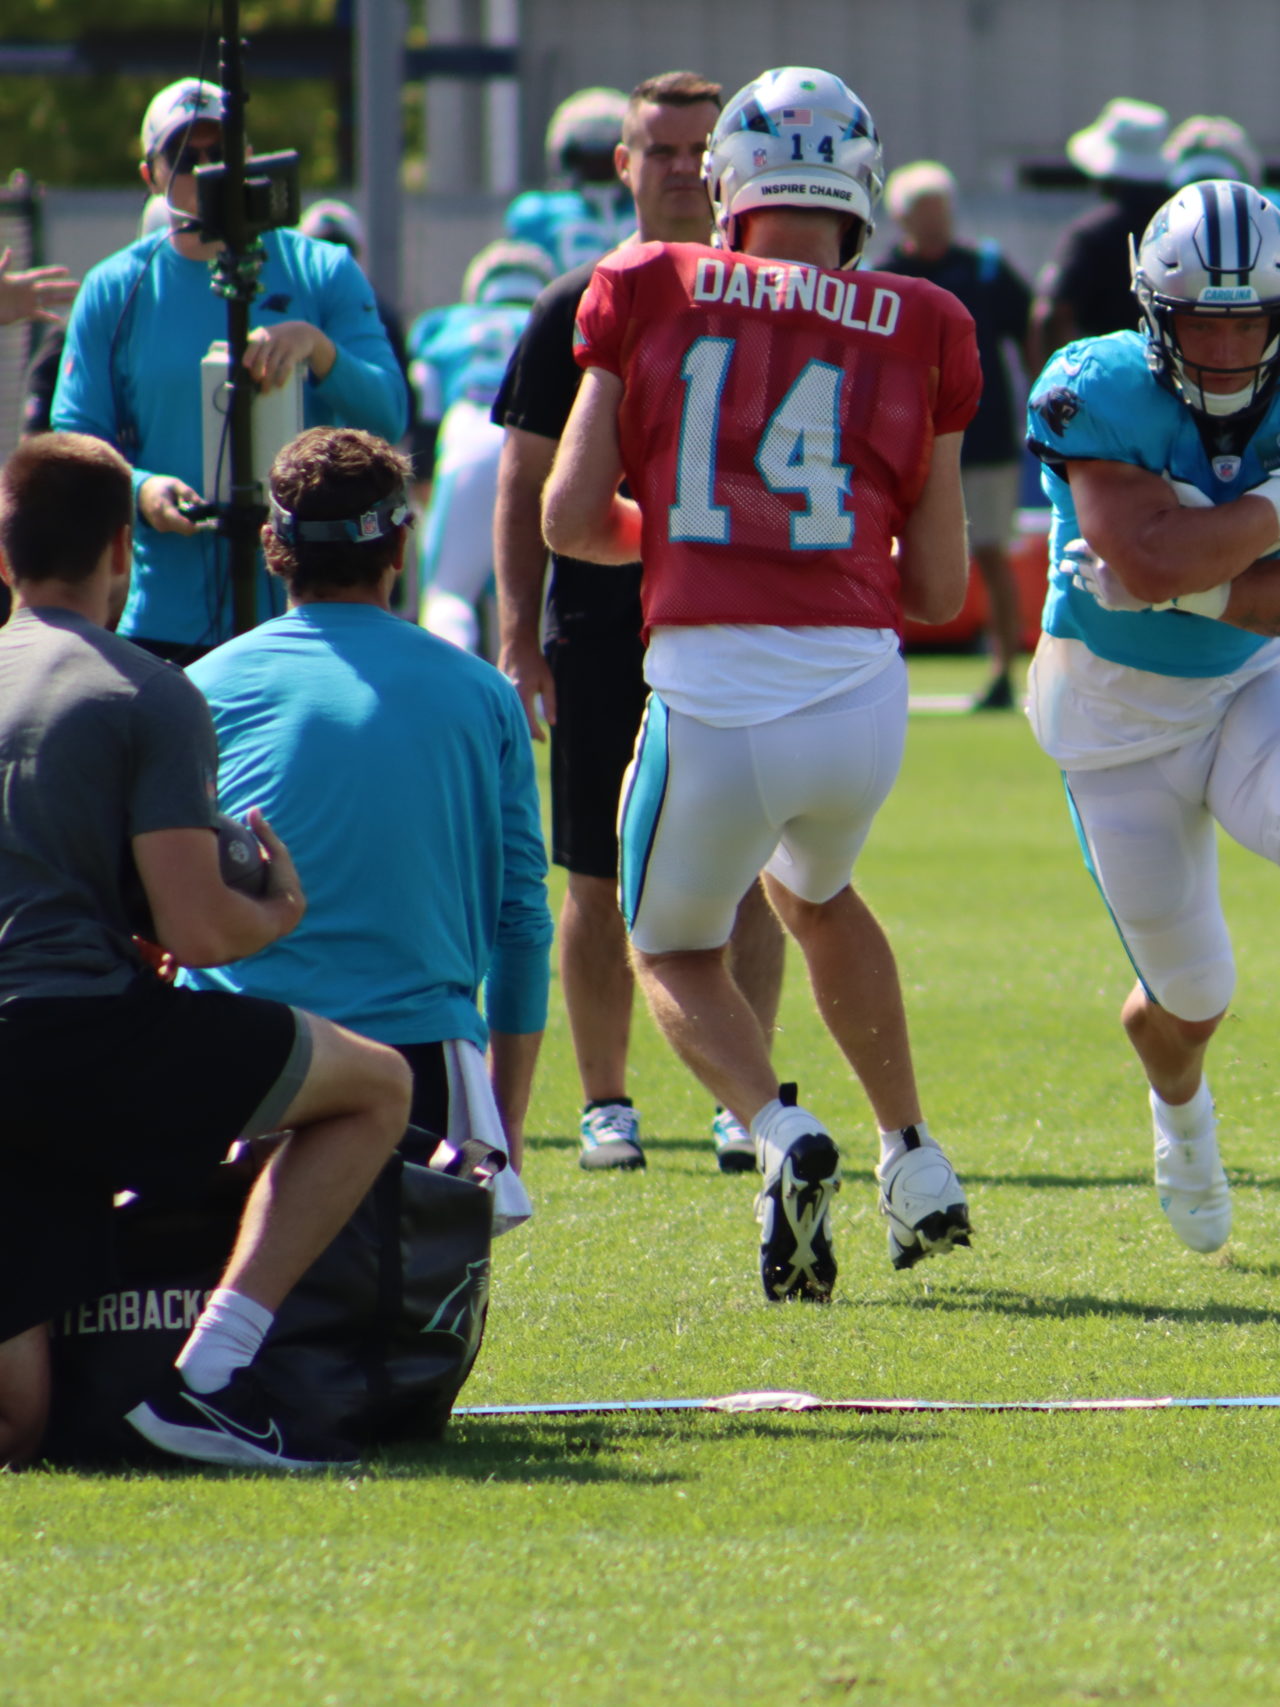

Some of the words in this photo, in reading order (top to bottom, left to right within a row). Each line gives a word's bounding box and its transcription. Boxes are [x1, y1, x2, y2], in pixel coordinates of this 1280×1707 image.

[761, 184, 806, 196] INSPIRE
[809, 185, 852, 202] CHANGE
[694, 257, 901, 336] DARNOLD
[1204, 288, 1252, 301] CAROLINA
[668, 335, 855, 551] 14
[64, 1289, 214, 1337] ERBACK
